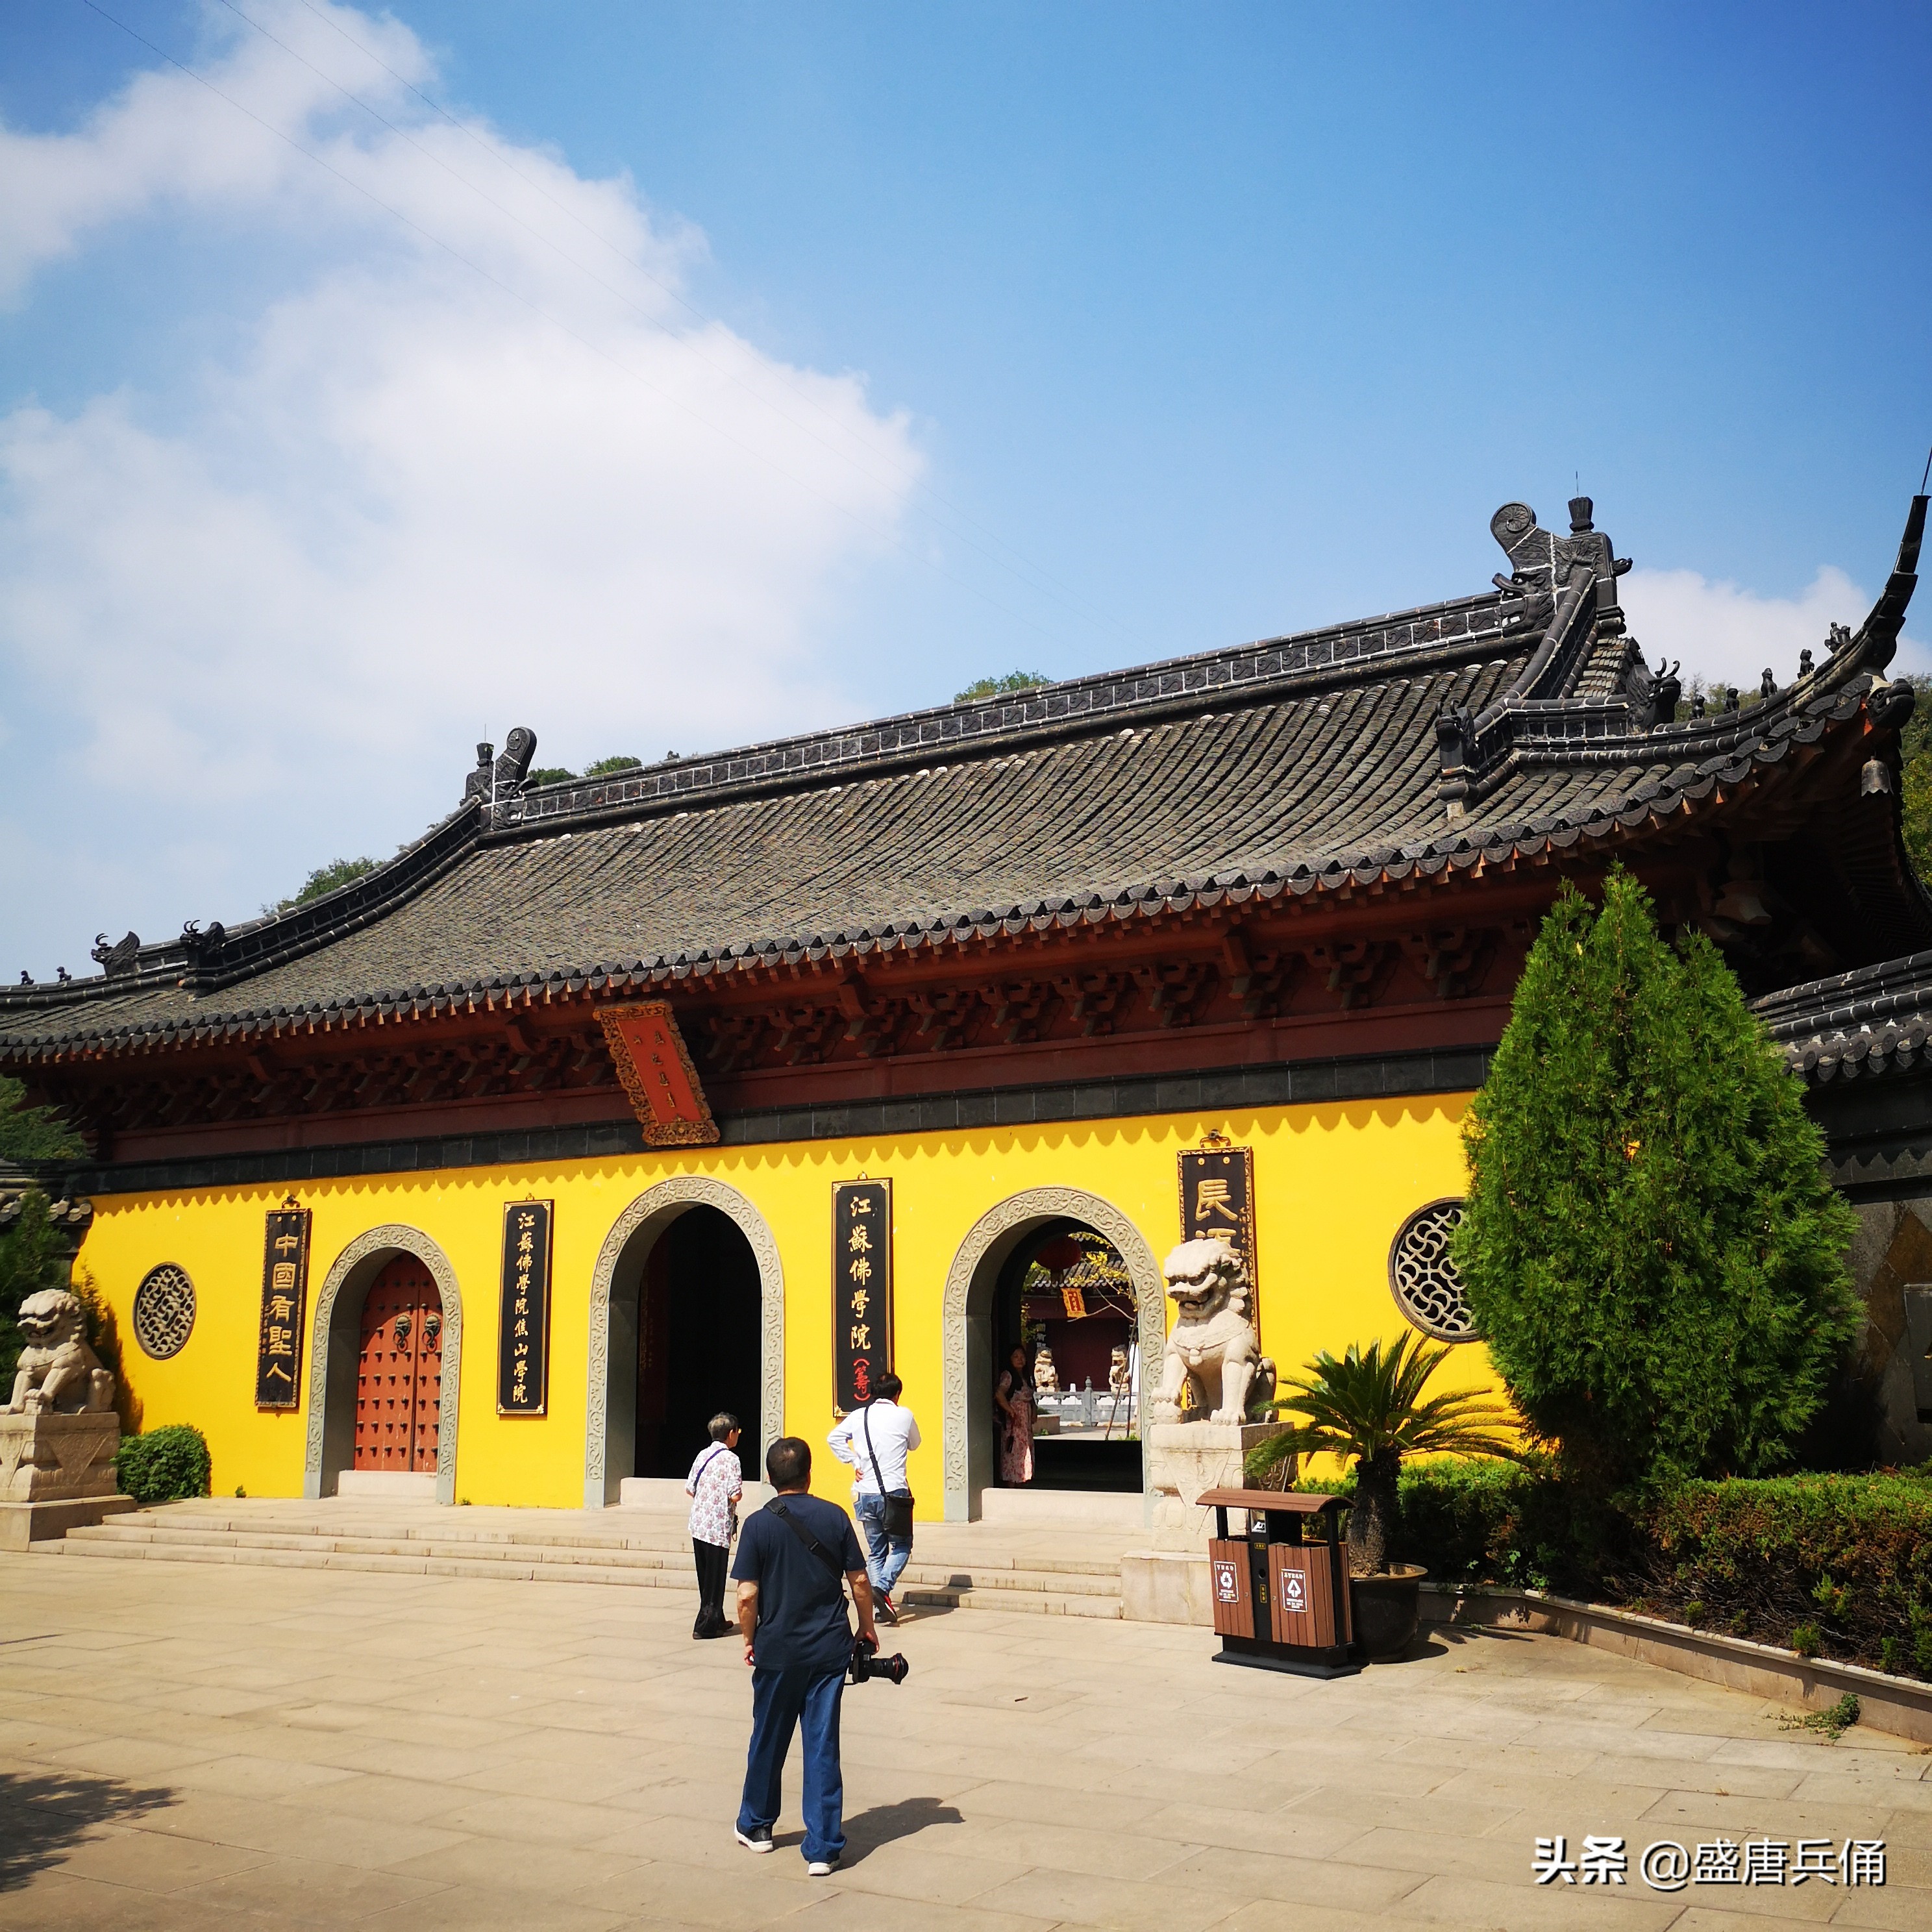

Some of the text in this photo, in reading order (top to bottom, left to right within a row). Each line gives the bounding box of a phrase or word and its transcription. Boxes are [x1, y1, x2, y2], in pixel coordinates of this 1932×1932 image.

[266, 1233, 299, 1383] 中國有聖人
[512, 1212, 536, 1404] 江蘇佛學院焦山學院
